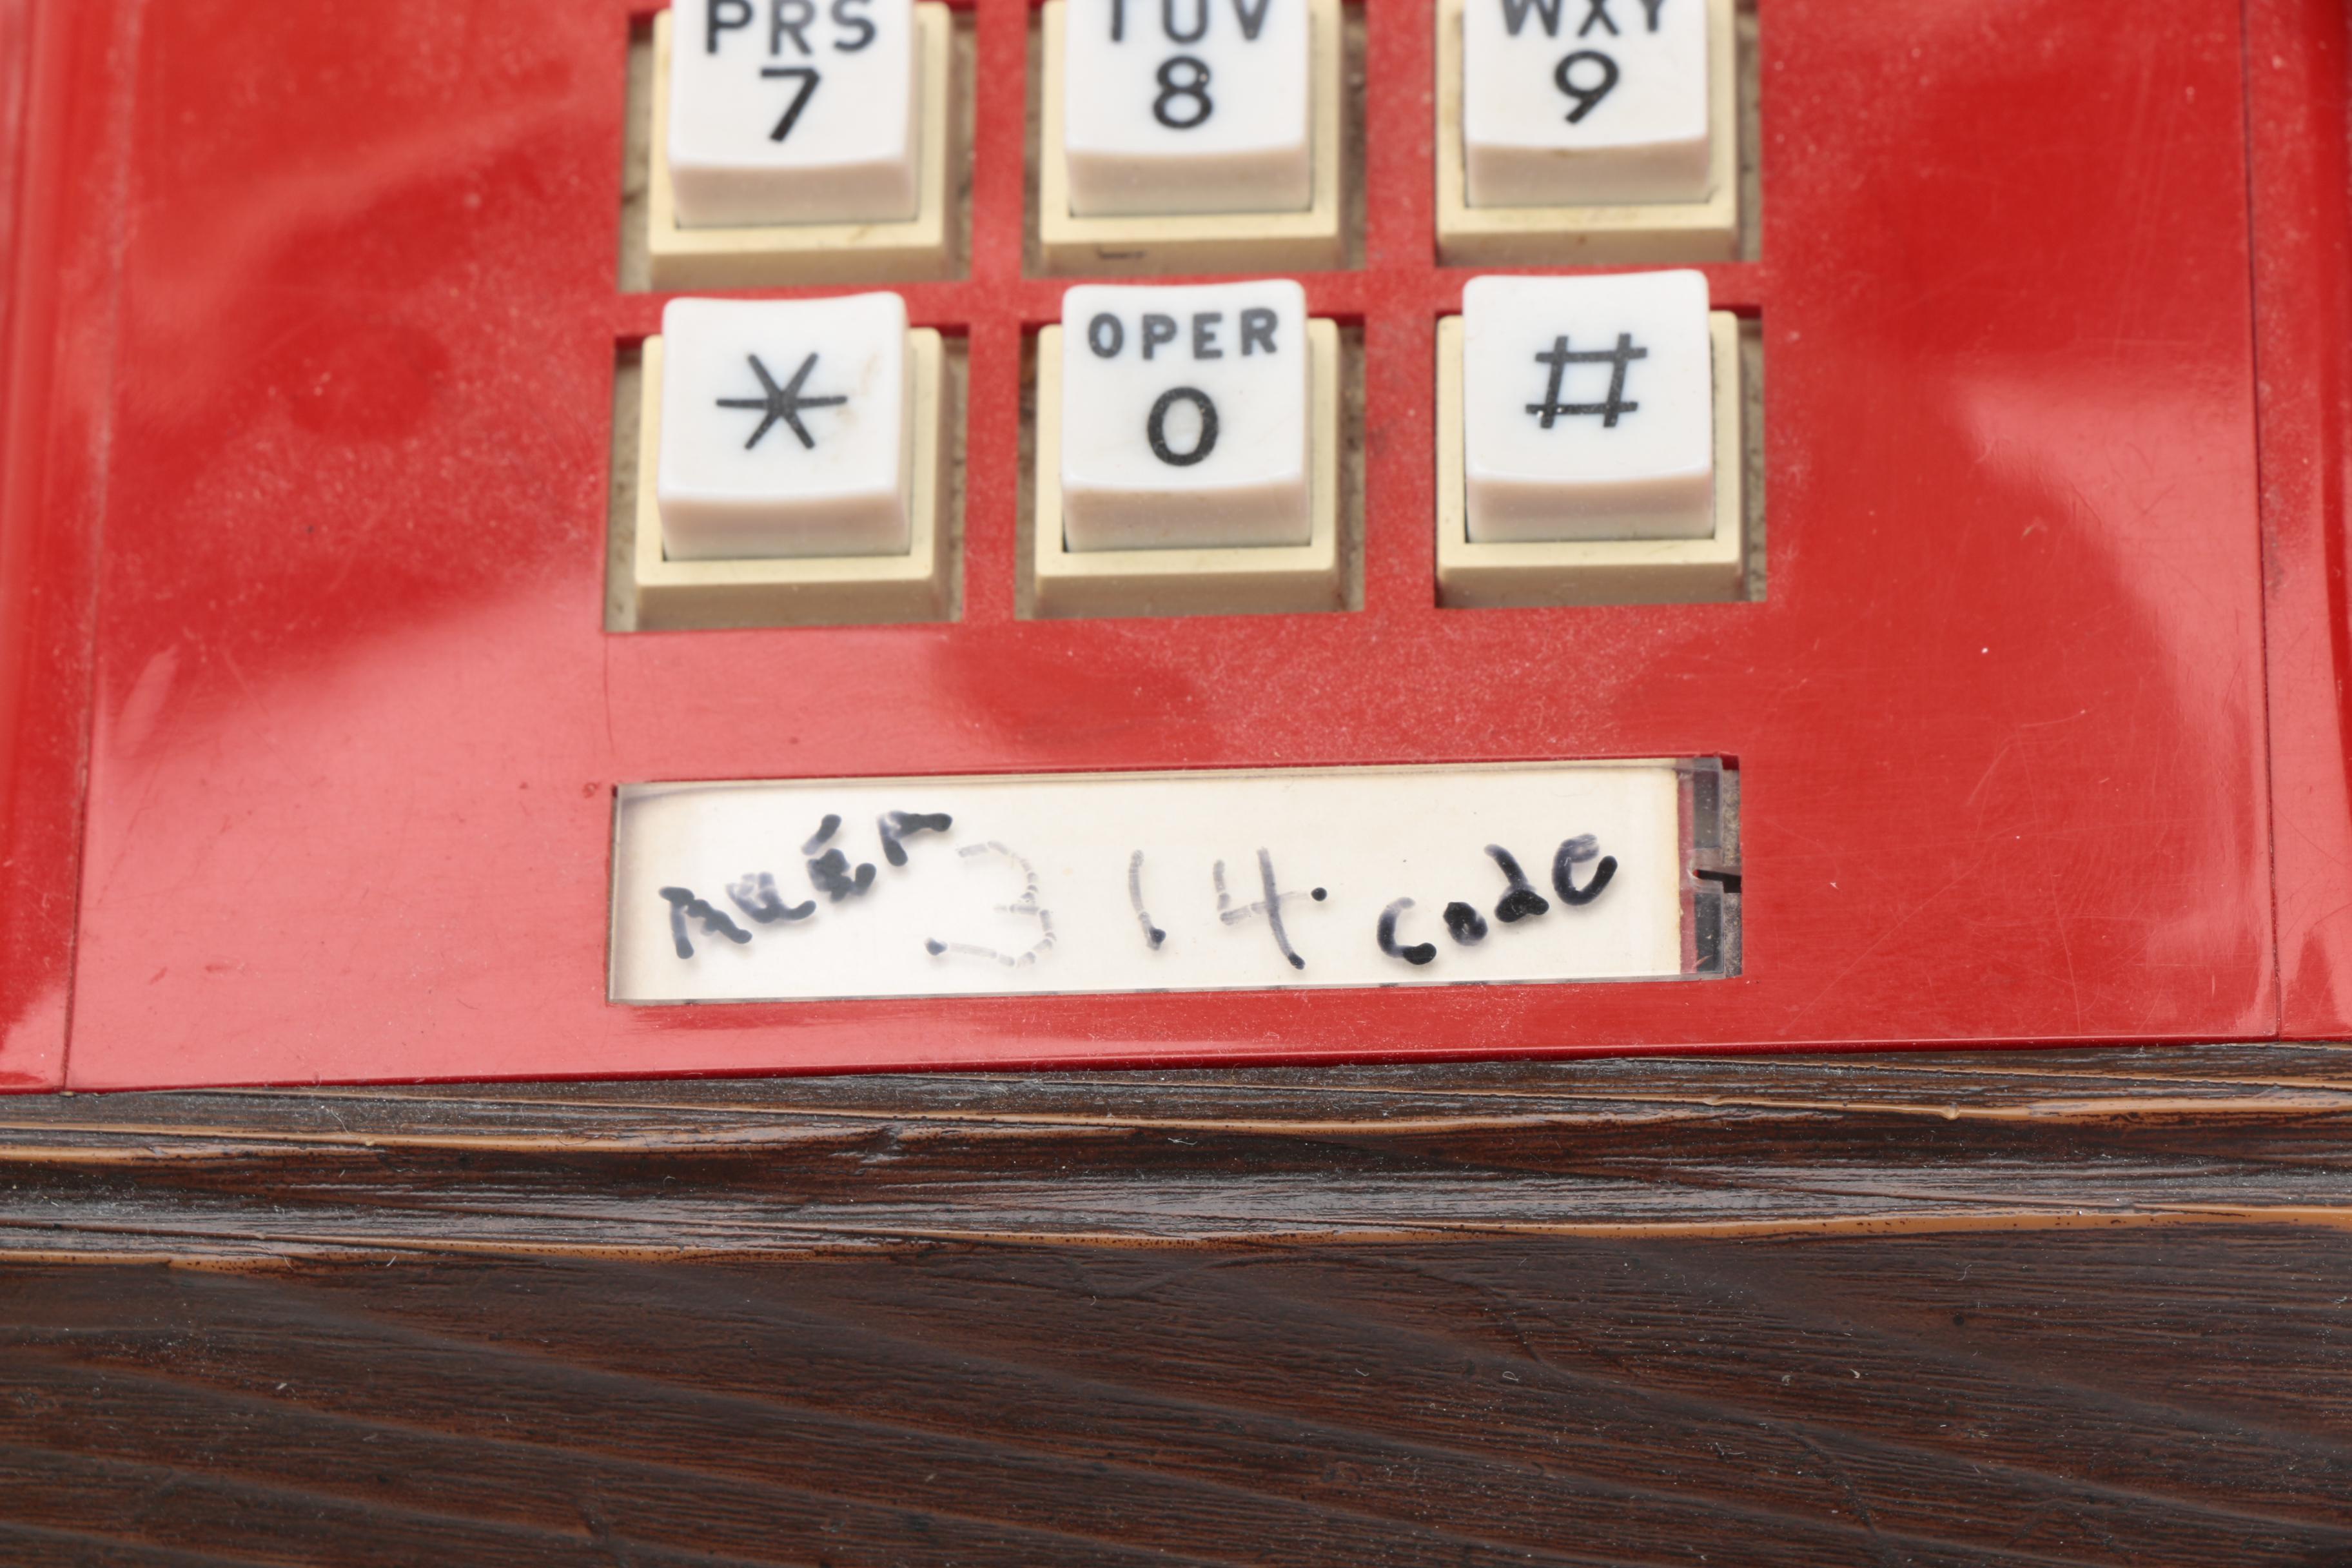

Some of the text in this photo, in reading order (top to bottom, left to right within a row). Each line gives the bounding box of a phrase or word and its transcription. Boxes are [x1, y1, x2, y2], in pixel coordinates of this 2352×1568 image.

[705, 0, 876, 55] PRS
[760, 66, 821, 143] 7
[1152, 54, 1214, 131] 8
[1553, 49, 1620, 125] 9
[1088, 308, 1279, 360] OPER
[1146, 386, 1220, 468] 0
